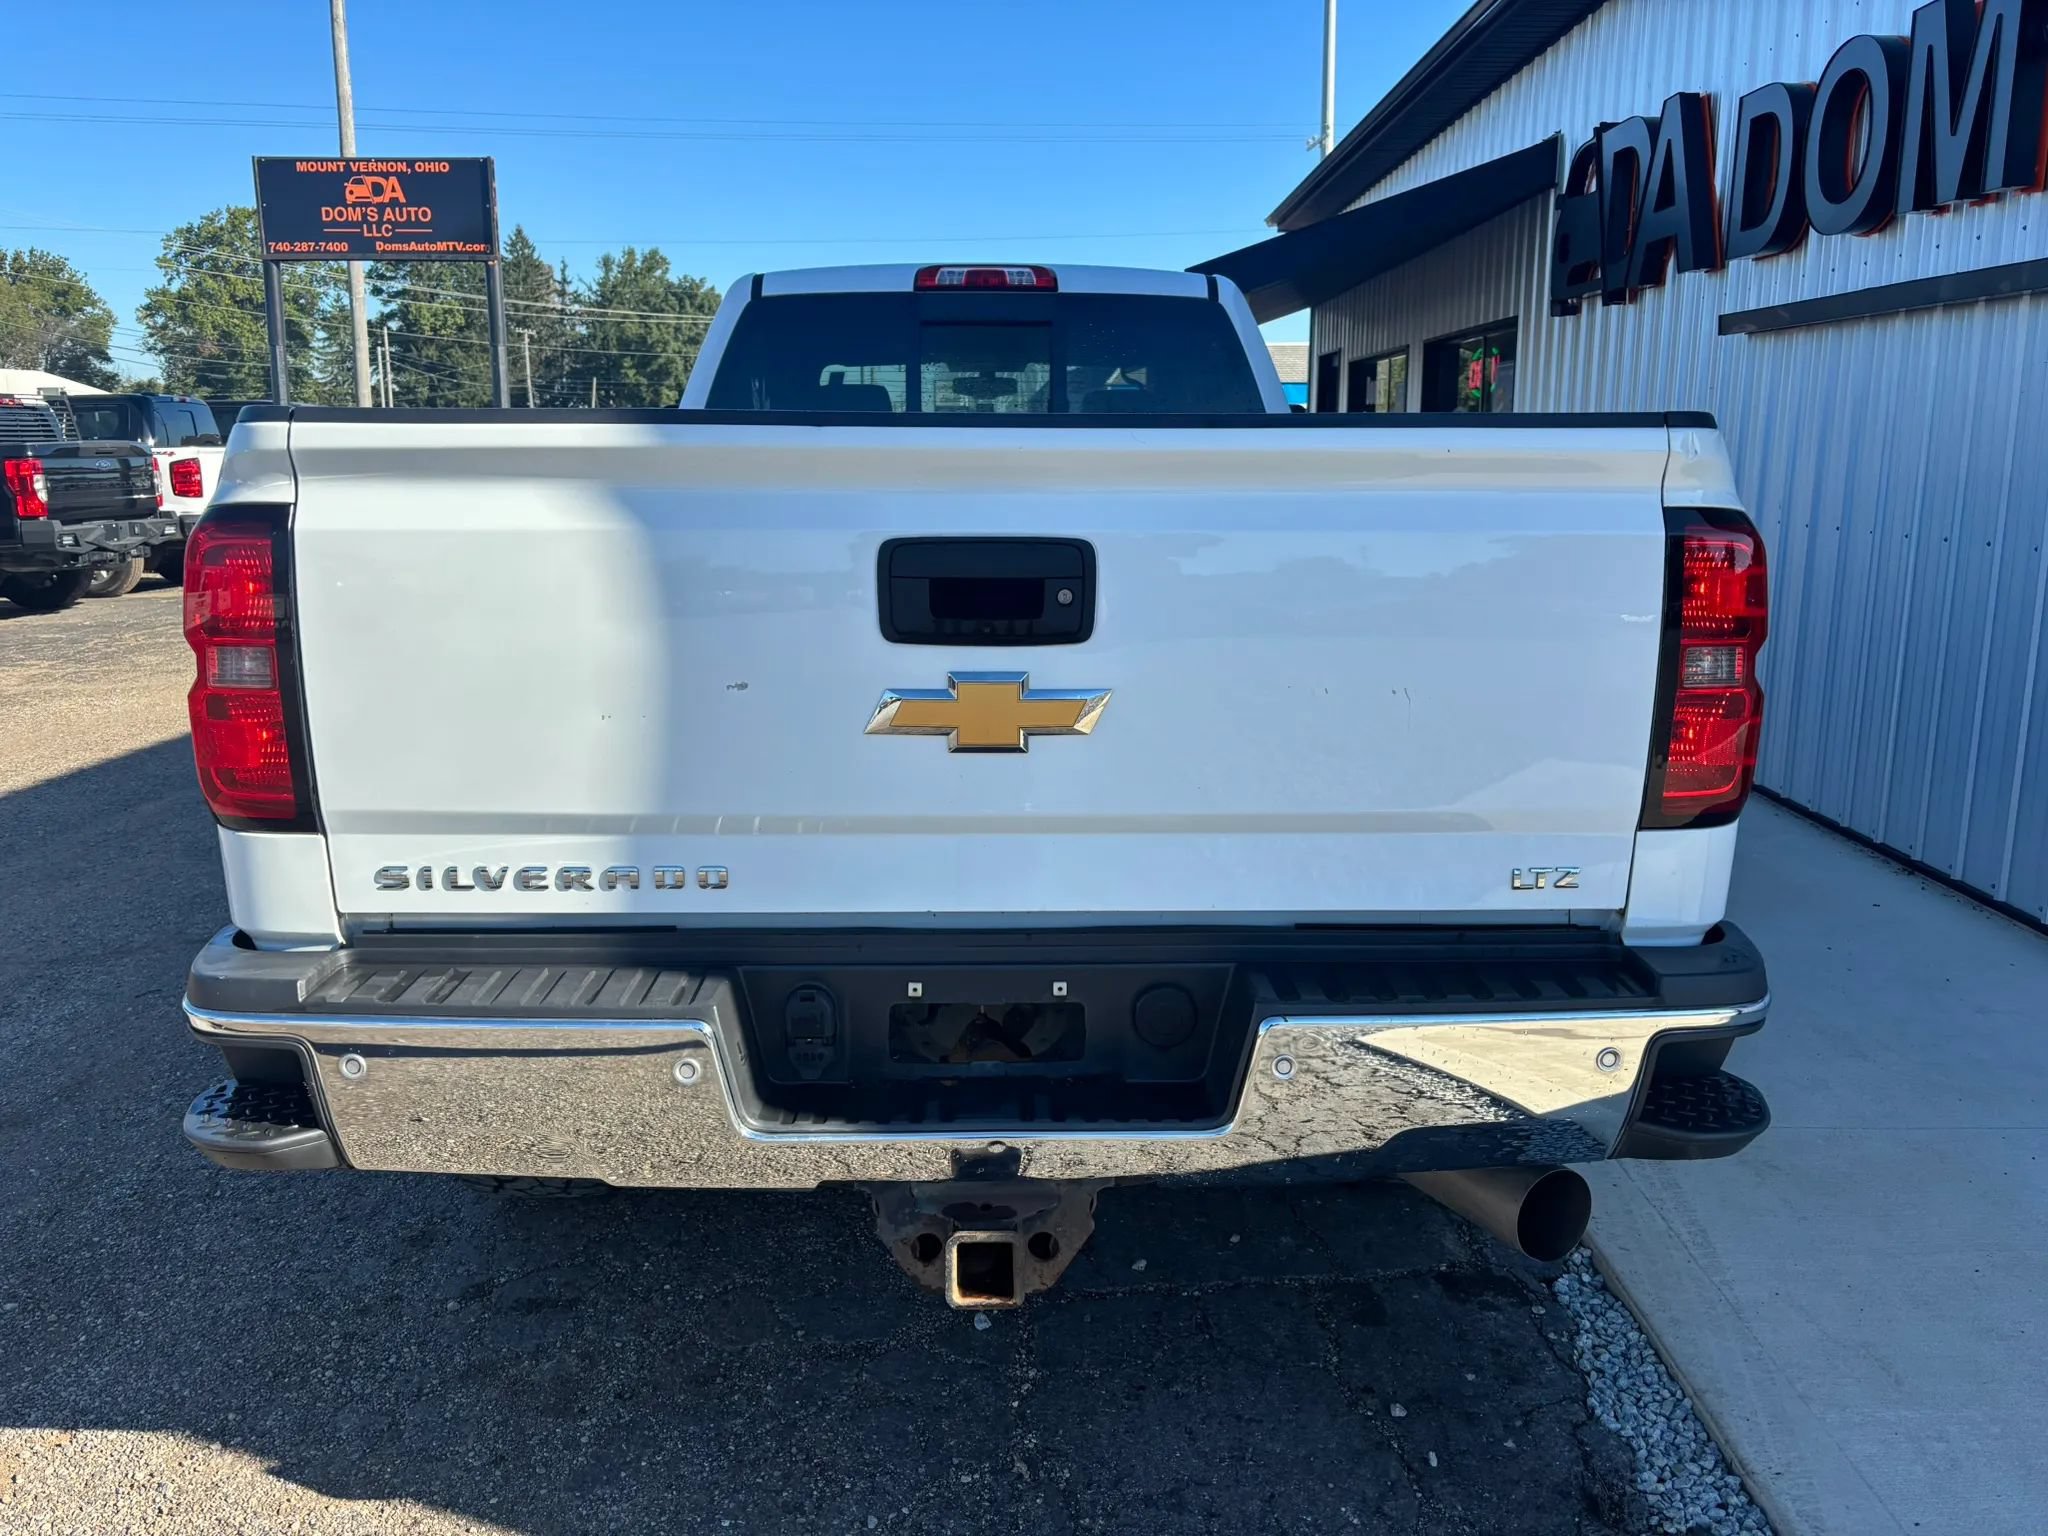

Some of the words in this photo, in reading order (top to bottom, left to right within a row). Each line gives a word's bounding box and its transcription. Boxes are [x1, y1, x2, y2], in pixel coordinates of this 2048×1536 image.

[296, 161, 345, 172] MOUNT
[350, 161, 411, 174] VERNON,
[415, 161, 449, 172] OHIO
[364, 176, 406, 204] DA
[321, 207, 378, 222] DOM'S
[383, 207, 432, 222] AUTO
[363, 224, 393, 237] LLC
[268, 241, 348, 252] 740-287-7400
[374, 865, 729, 891] SILVERADO
[1511, 867, 1581, 890] LTZ
